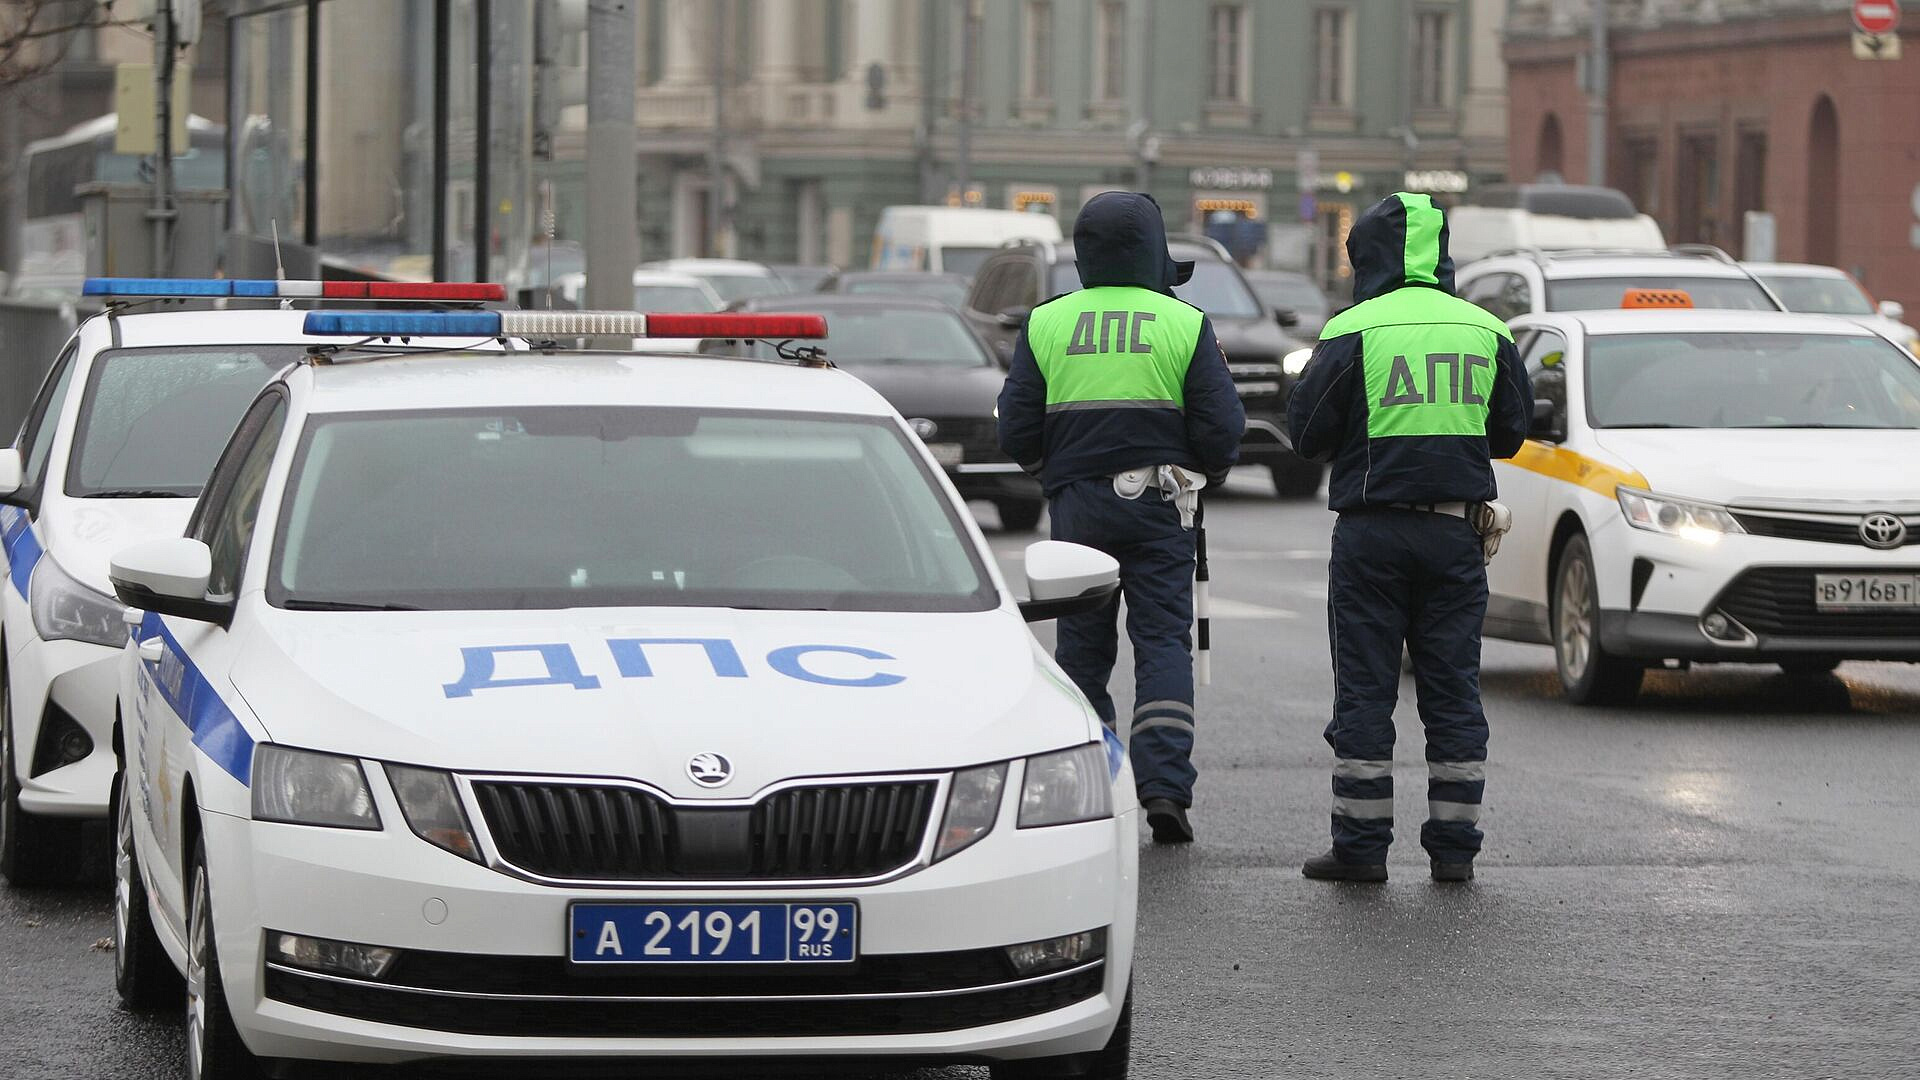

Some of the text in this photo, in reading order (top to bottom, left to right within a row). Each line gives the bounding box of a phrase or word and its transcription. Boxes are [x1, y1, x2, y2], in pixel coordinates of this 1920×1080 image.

[1066, 311, 1156, 355] ДПС
[1379, 353, 1489, 407] ДПС
[1823, 578, 1911, 602] В916ВТ
[441, 638, 907, 698] ДПС
[643, 910, 761, 956] 2191
[793, 907, 840, 943] 99
[799, 944, 833, 957] RUS
